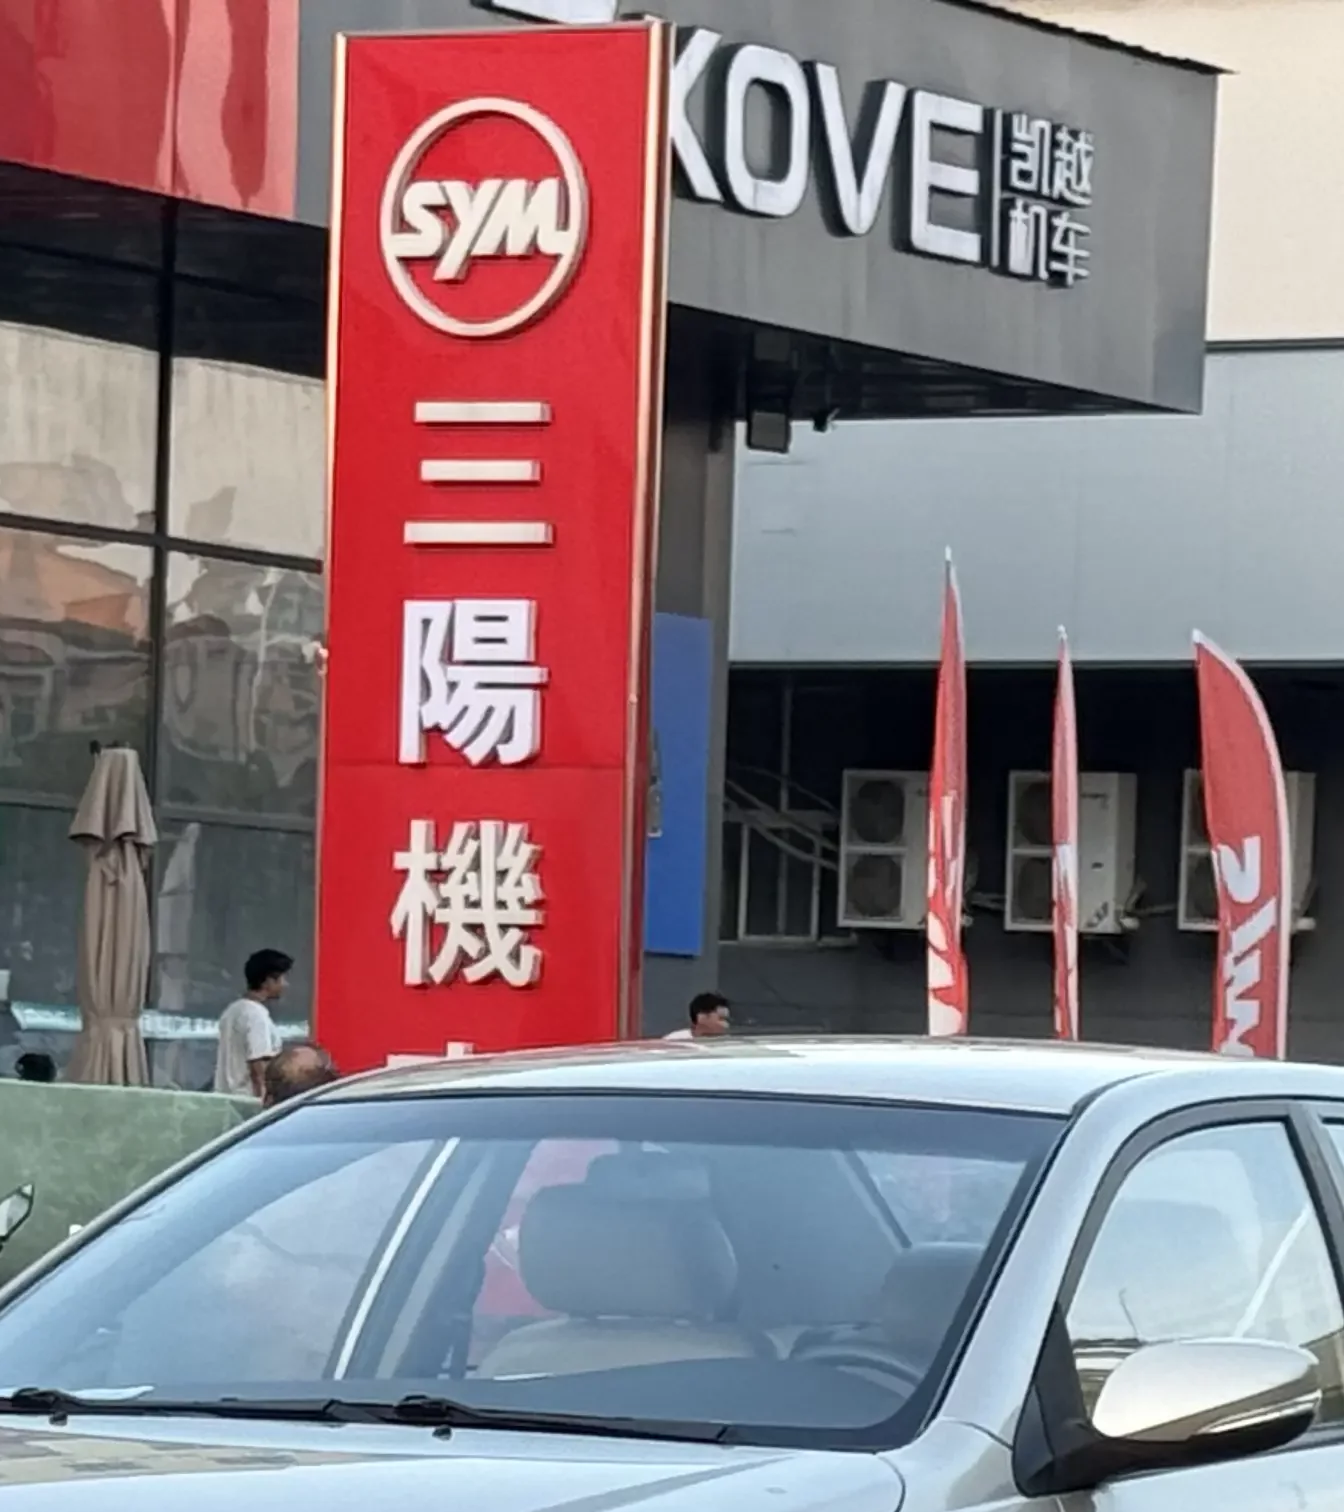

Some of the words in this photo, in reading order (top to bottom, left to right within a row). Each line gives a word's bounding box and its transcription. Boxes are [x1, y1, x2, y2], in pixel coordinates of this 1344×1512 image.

[670, 28, 984, 262] KOVE
[1008, 113, 1094, 205] 凯越
[388, 177, 572, 282] SYM
[1007, 198, 1092, 286] 机车
[388, 400, 553, 1070] 三陽機
